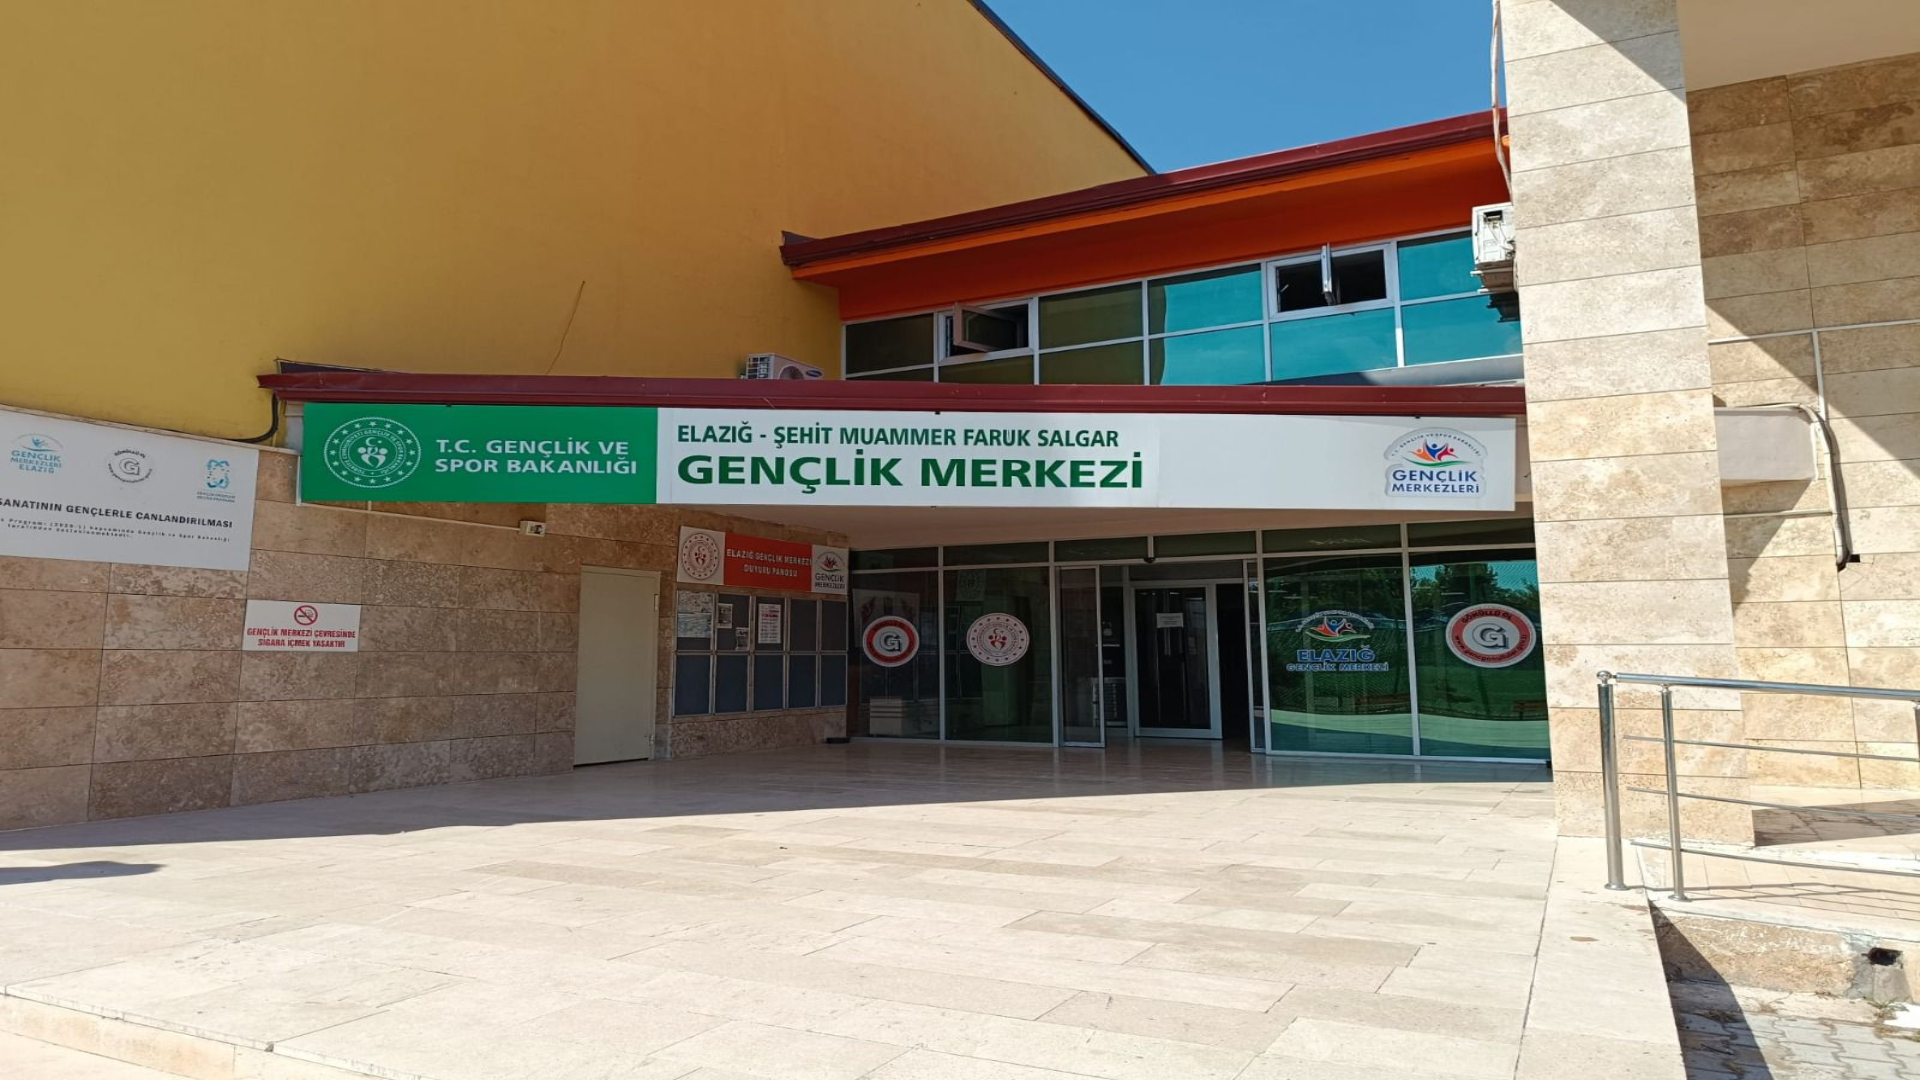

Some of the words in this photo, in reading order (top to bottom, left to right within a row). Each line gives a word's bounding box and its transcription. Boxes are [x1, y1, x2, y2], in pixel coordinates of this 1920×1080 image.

[678, 421, 752, 443] ELAZIĞ
[773, 422, 833, 449] ŞEHİT
[840, 427, 956, 446] MUAMMER
[963, 429, 1031, 447] FARUK
[1037, 430, 1119, 447] SALGAR
[436, 439, 477, 453] T.C.
[486, 437, 589, 459] GENÇLİK
[599, 442, 629, 455] VE
[436, 458, 498, 473] SPOR
[507, 456, 637, 474] BAKANLIĞI
[677, 449, 903, 494] GENÇLİK
[921, 452, 1142, 488] MERKEZİ
[1392, 470, 1477, 483] GENÇLİK
[1392, 483, 1479, 493] MERKEZLERİ
[66, 505, 133, 519] GENÇLERLE
[136, 512, 233, 528] CANLANDIRILMASI
[743, 563, 770, 575] DUYURU
[772, 567, 798, 577] PANOSU
[247, 627, 279, 638] GENÇLİK
[280, 628, 312, 637] MERKEZİ
[314, 629, 356, 638] ÇEVRESİNDE
[287, 638, 310, 648] İÇMEK
[313, 640, 345, 648] YASAKTIR
[1297, 645, 1375, 662] ELAZIĞ
